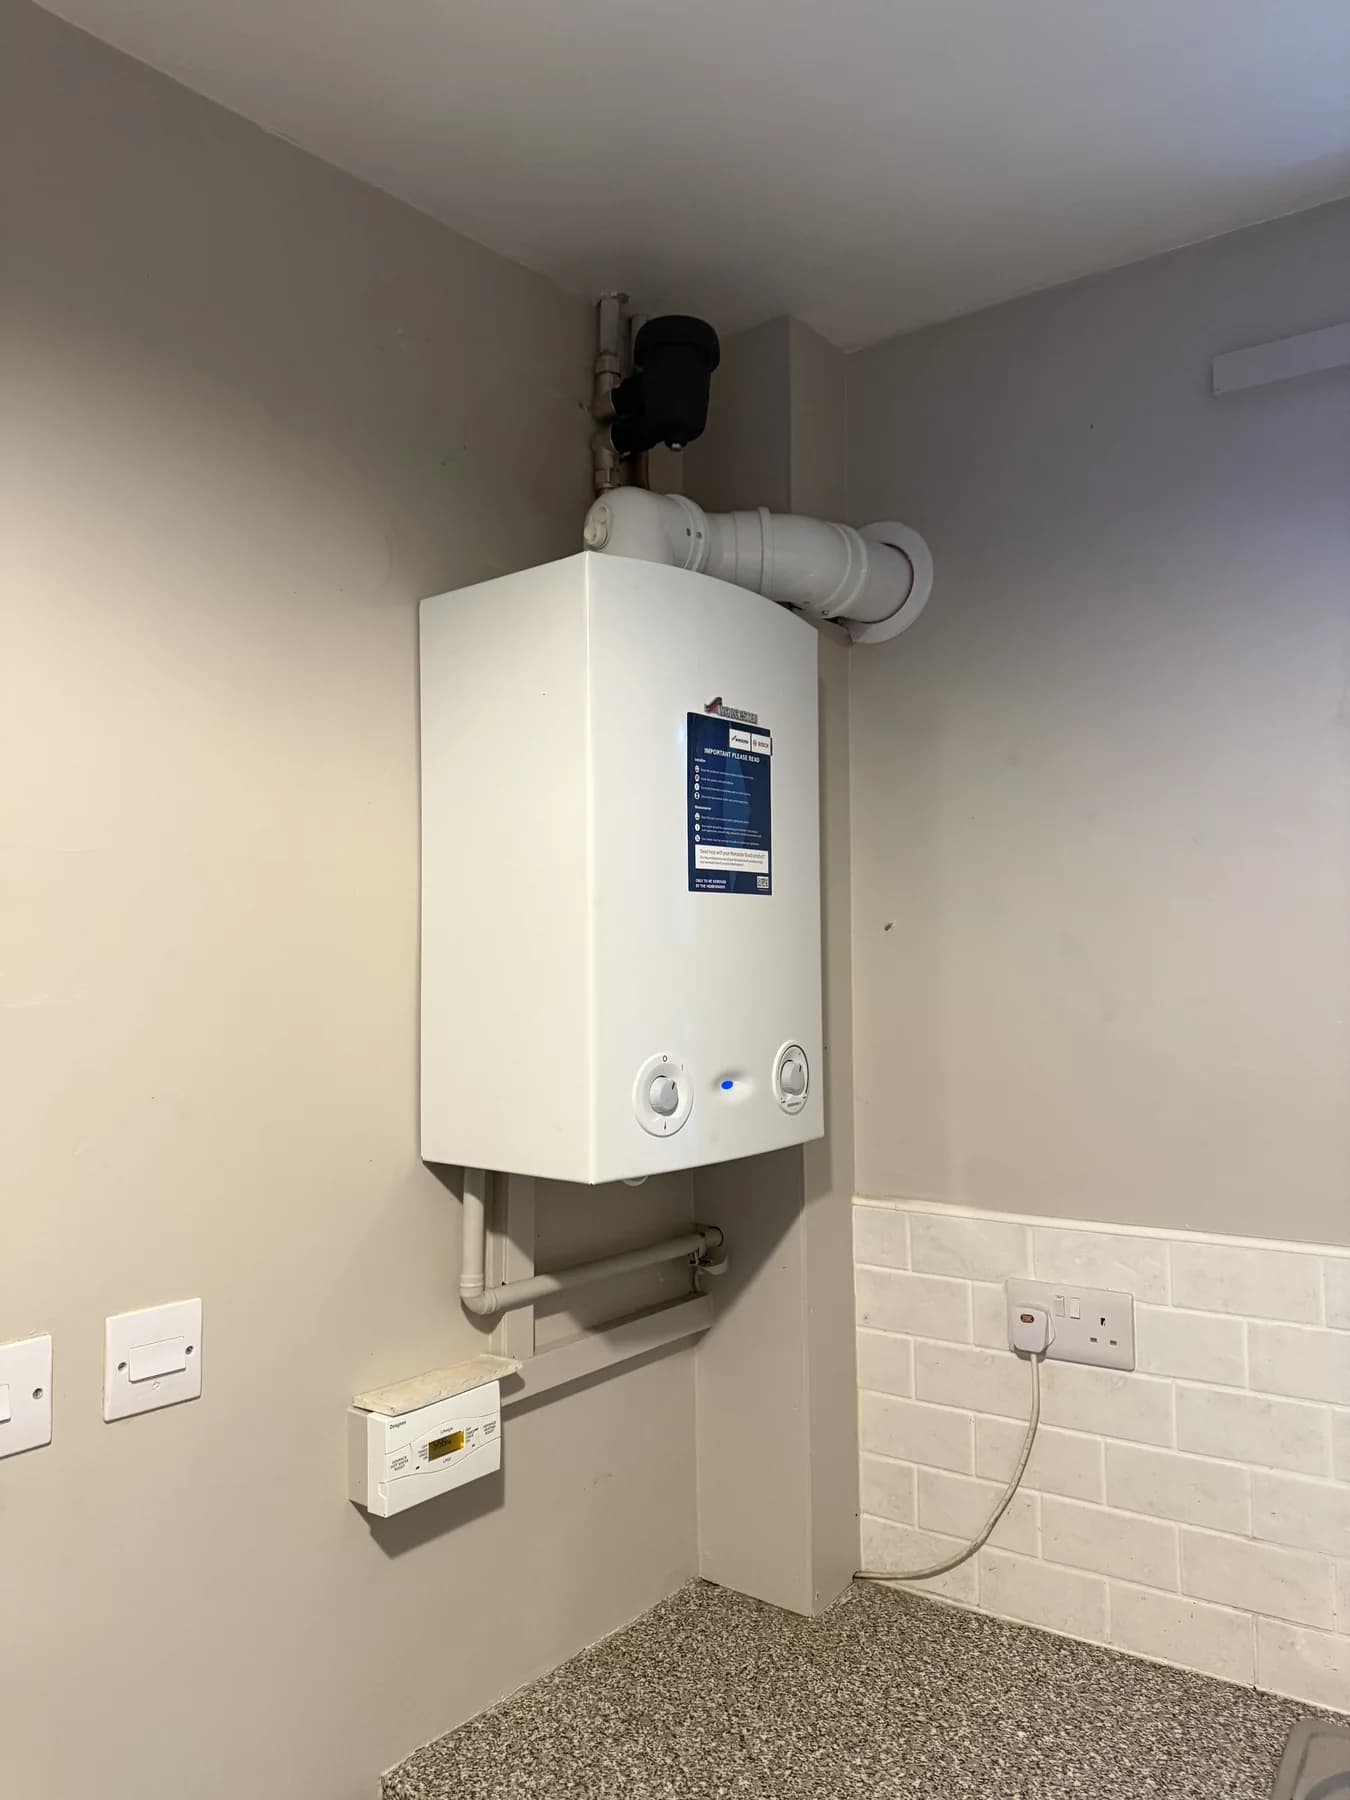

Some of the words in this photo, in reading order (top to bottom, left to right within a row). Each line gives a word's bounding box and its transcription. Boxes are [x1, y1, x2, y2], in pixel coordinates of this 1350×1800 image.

[704, 748, 730, 757] IMPORTANT
[732, 752, 748, 760] PLEASE
[748, 755, 760, 763] READ
